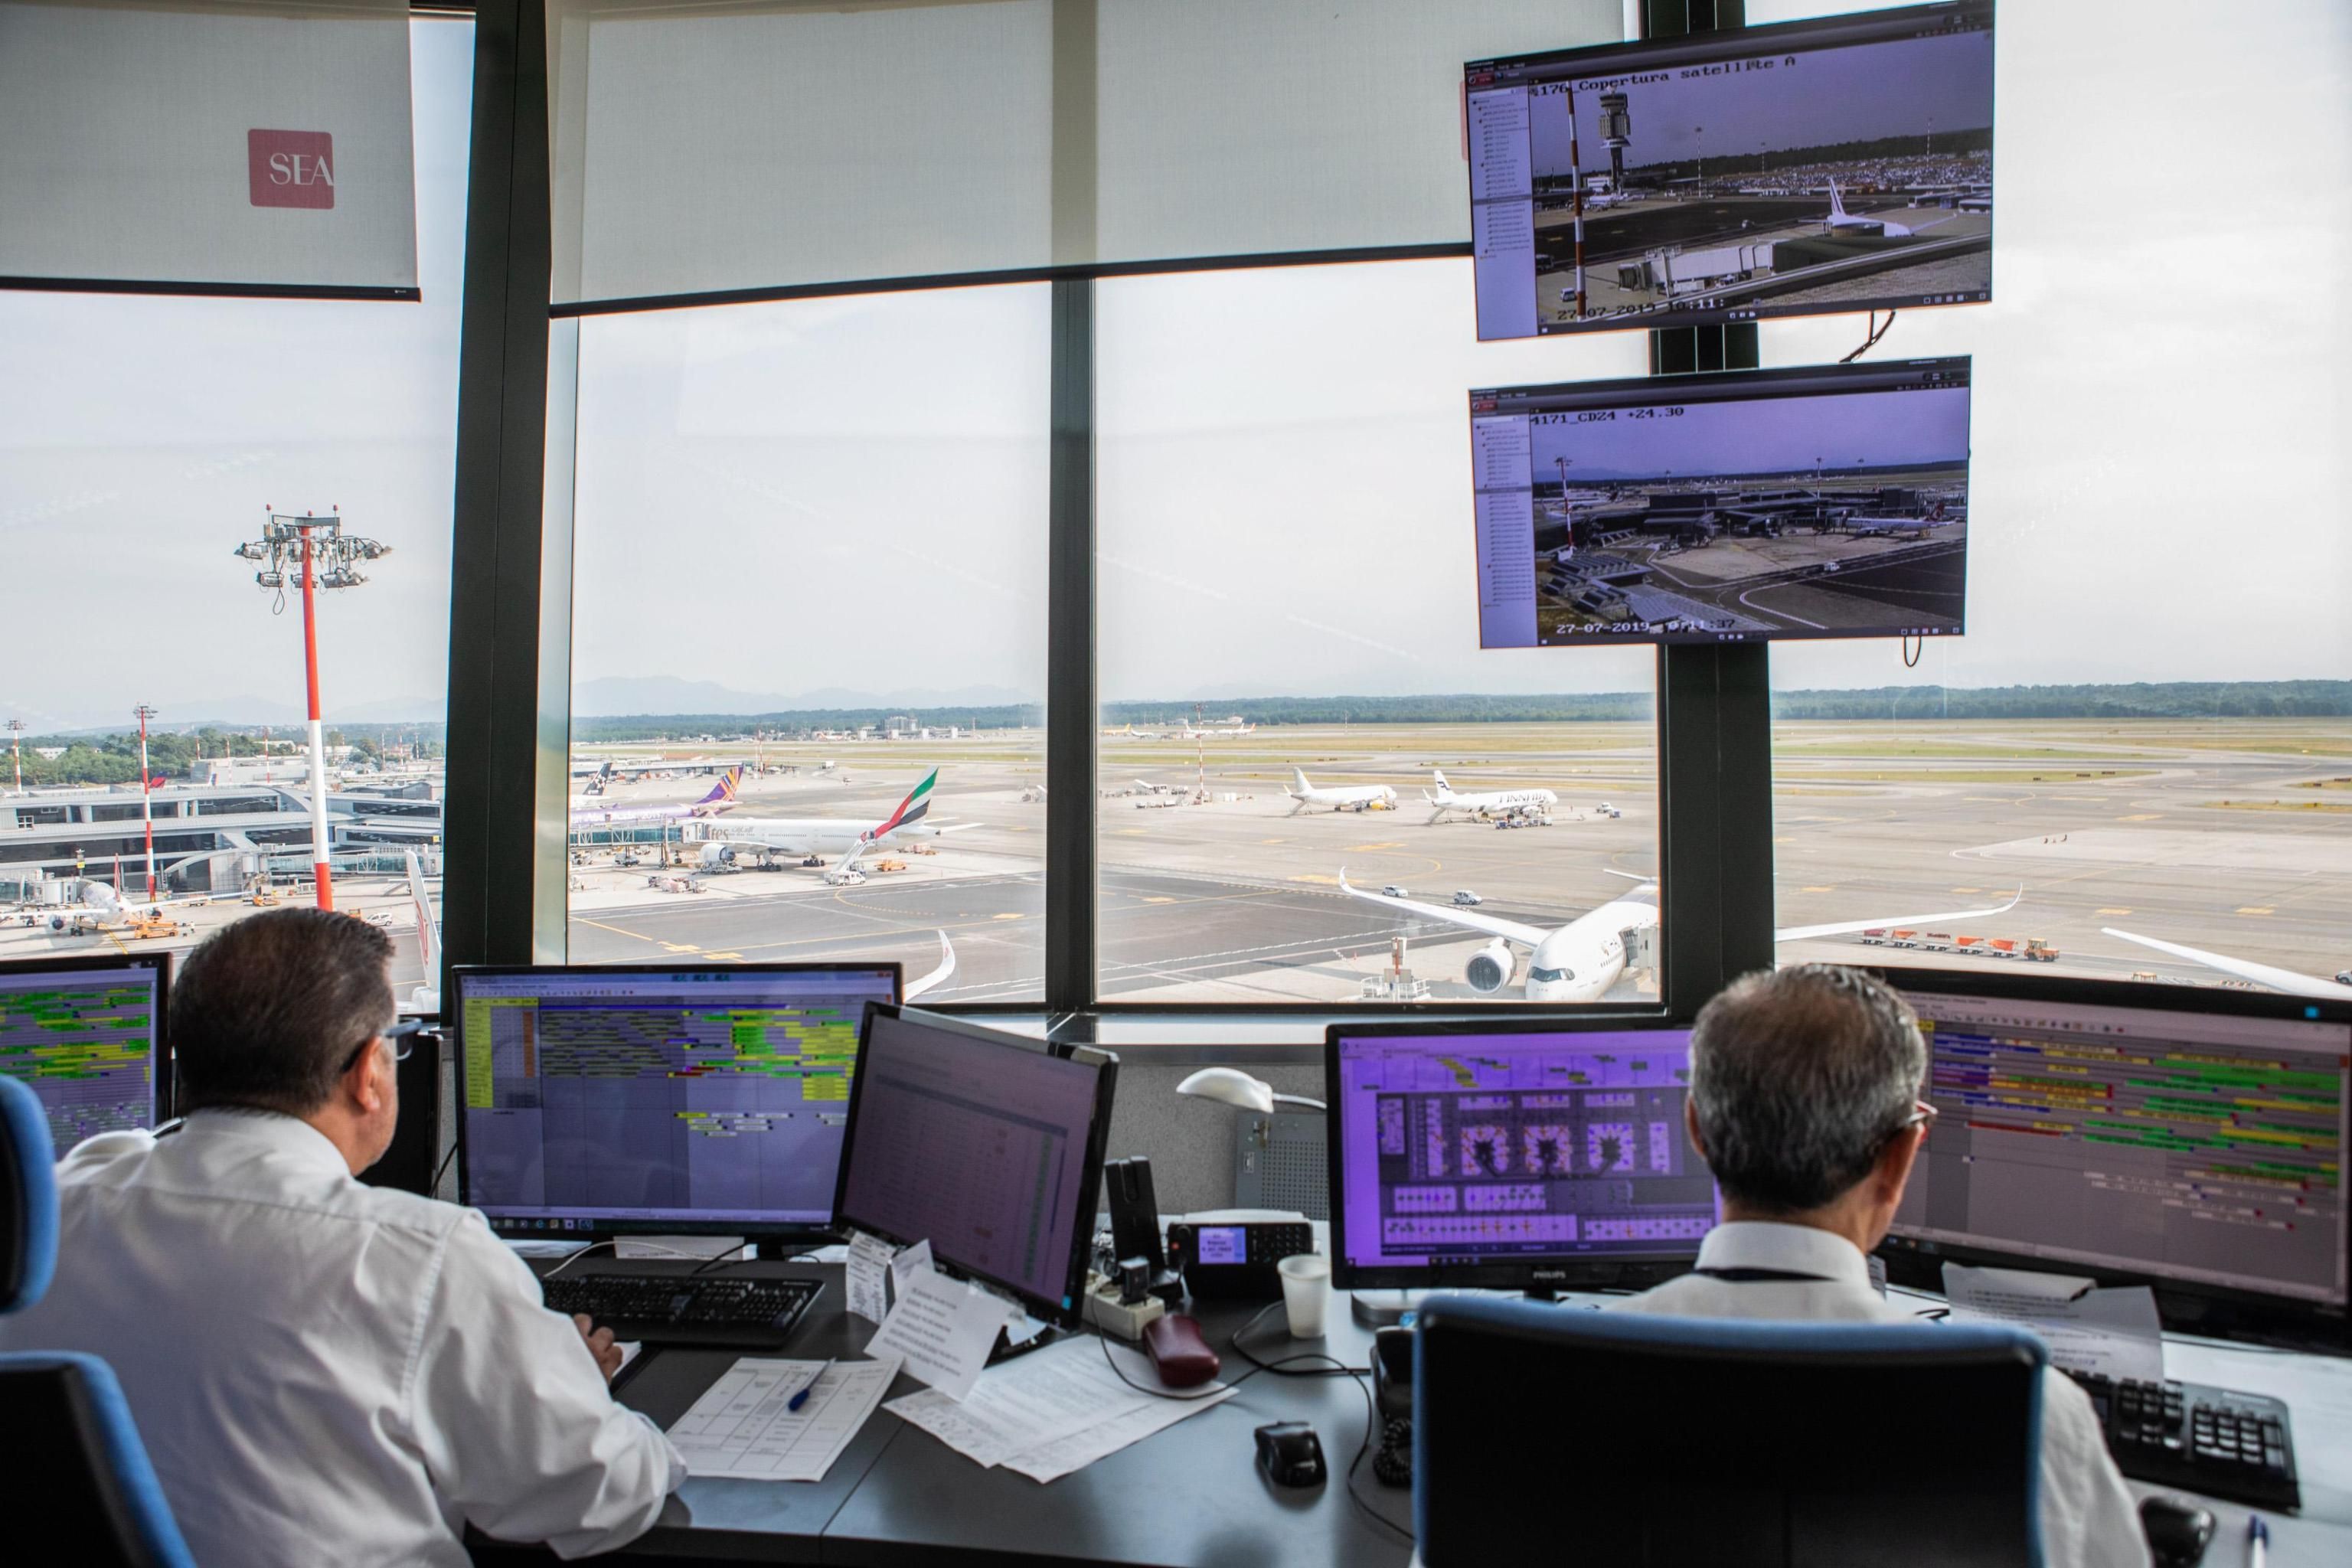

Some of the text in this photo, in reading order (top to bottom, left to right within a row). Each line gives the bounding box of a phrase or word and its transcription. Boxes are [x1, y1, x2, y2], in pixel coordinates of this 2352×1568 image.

[1785, 55, 1795, 67] A
[270, 152, 334, 187] SEA
[1557, 302, 1656, 320] 2707-2019
[1628, 407, 1684, 419] +24.30
[1557, 621, 1650, 634] 27-07-2019
